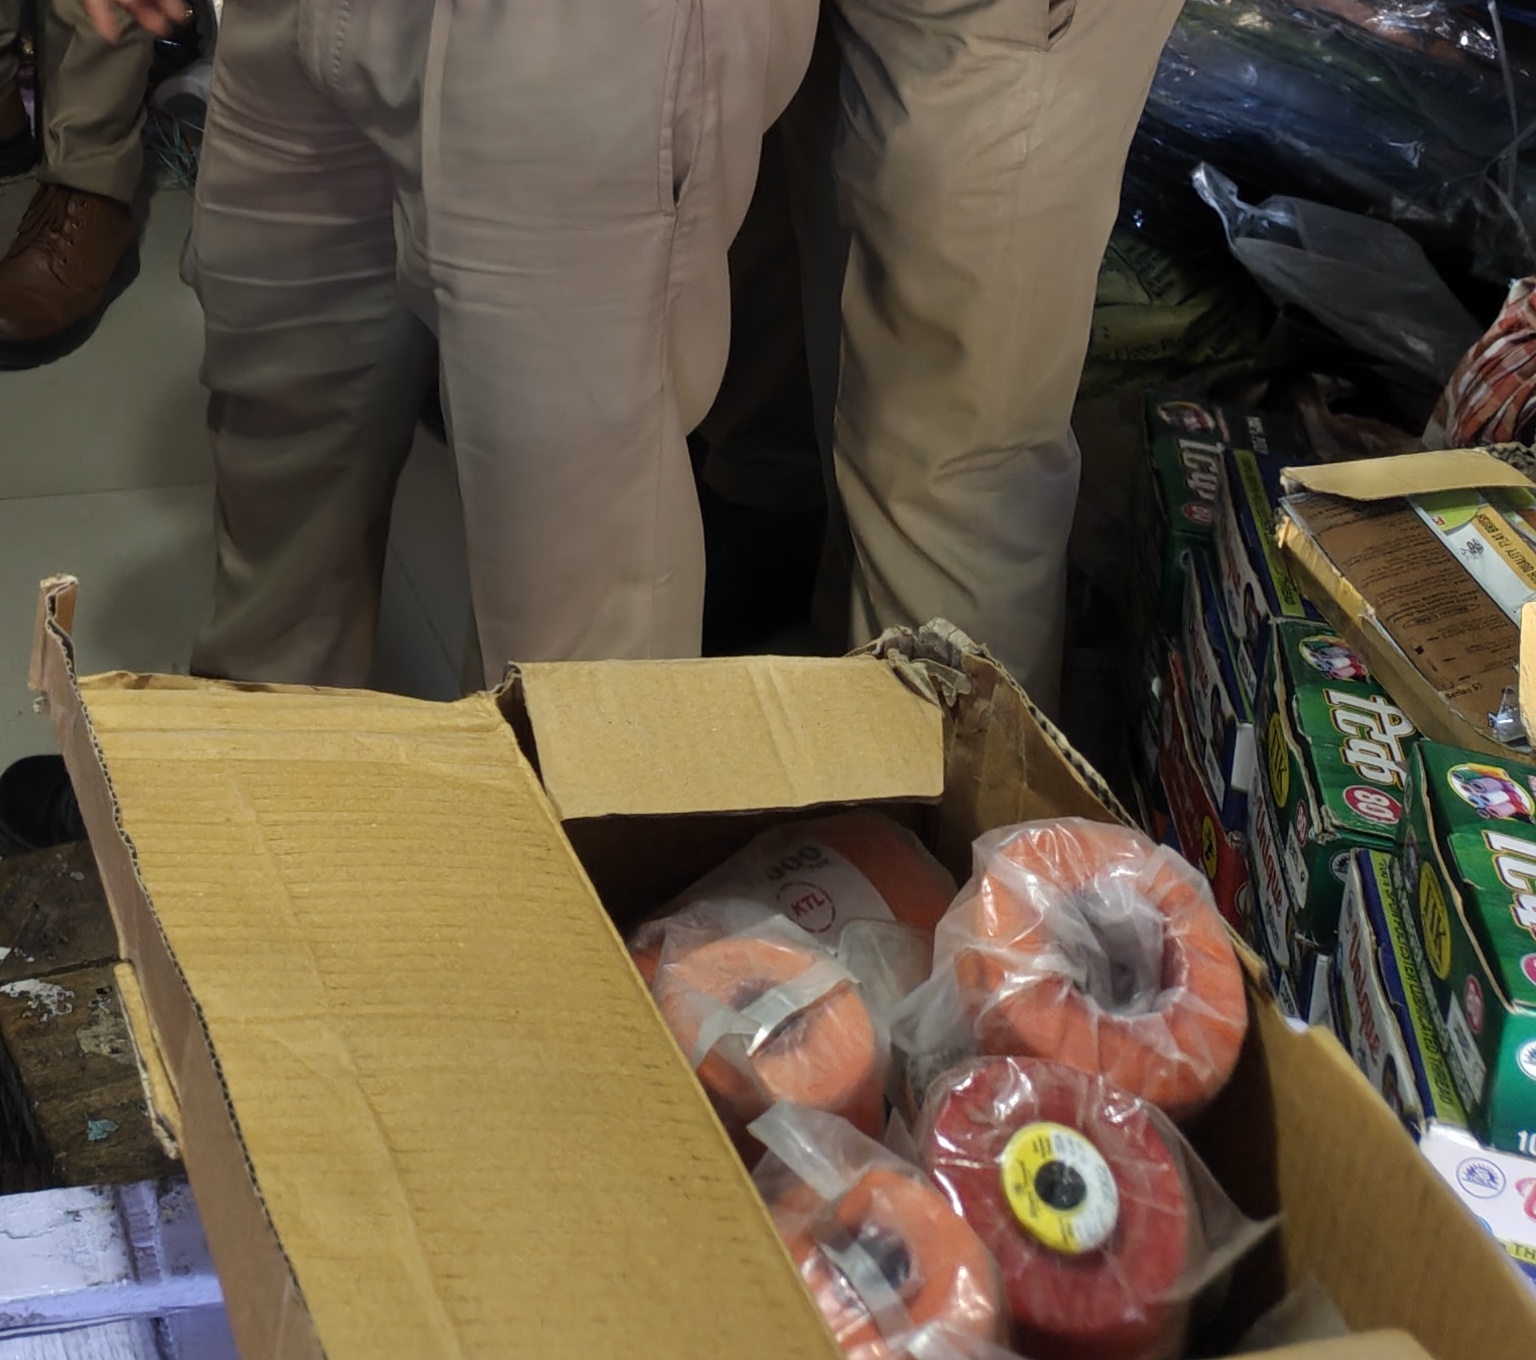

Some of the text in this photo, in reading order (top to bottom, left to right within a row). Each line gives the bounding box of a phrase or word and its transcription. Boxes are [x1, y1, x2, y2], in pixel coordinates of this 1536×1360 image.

[1322, 686, 1422, 788] टिक
[1350, 789, 1397, 821] 80
[790, 892, 826, 917] KTL
[1252, 798, 1284, 917] Unique
[1389, 918, 1454, 1107] POLYESTER LUBRICATED THREAD
